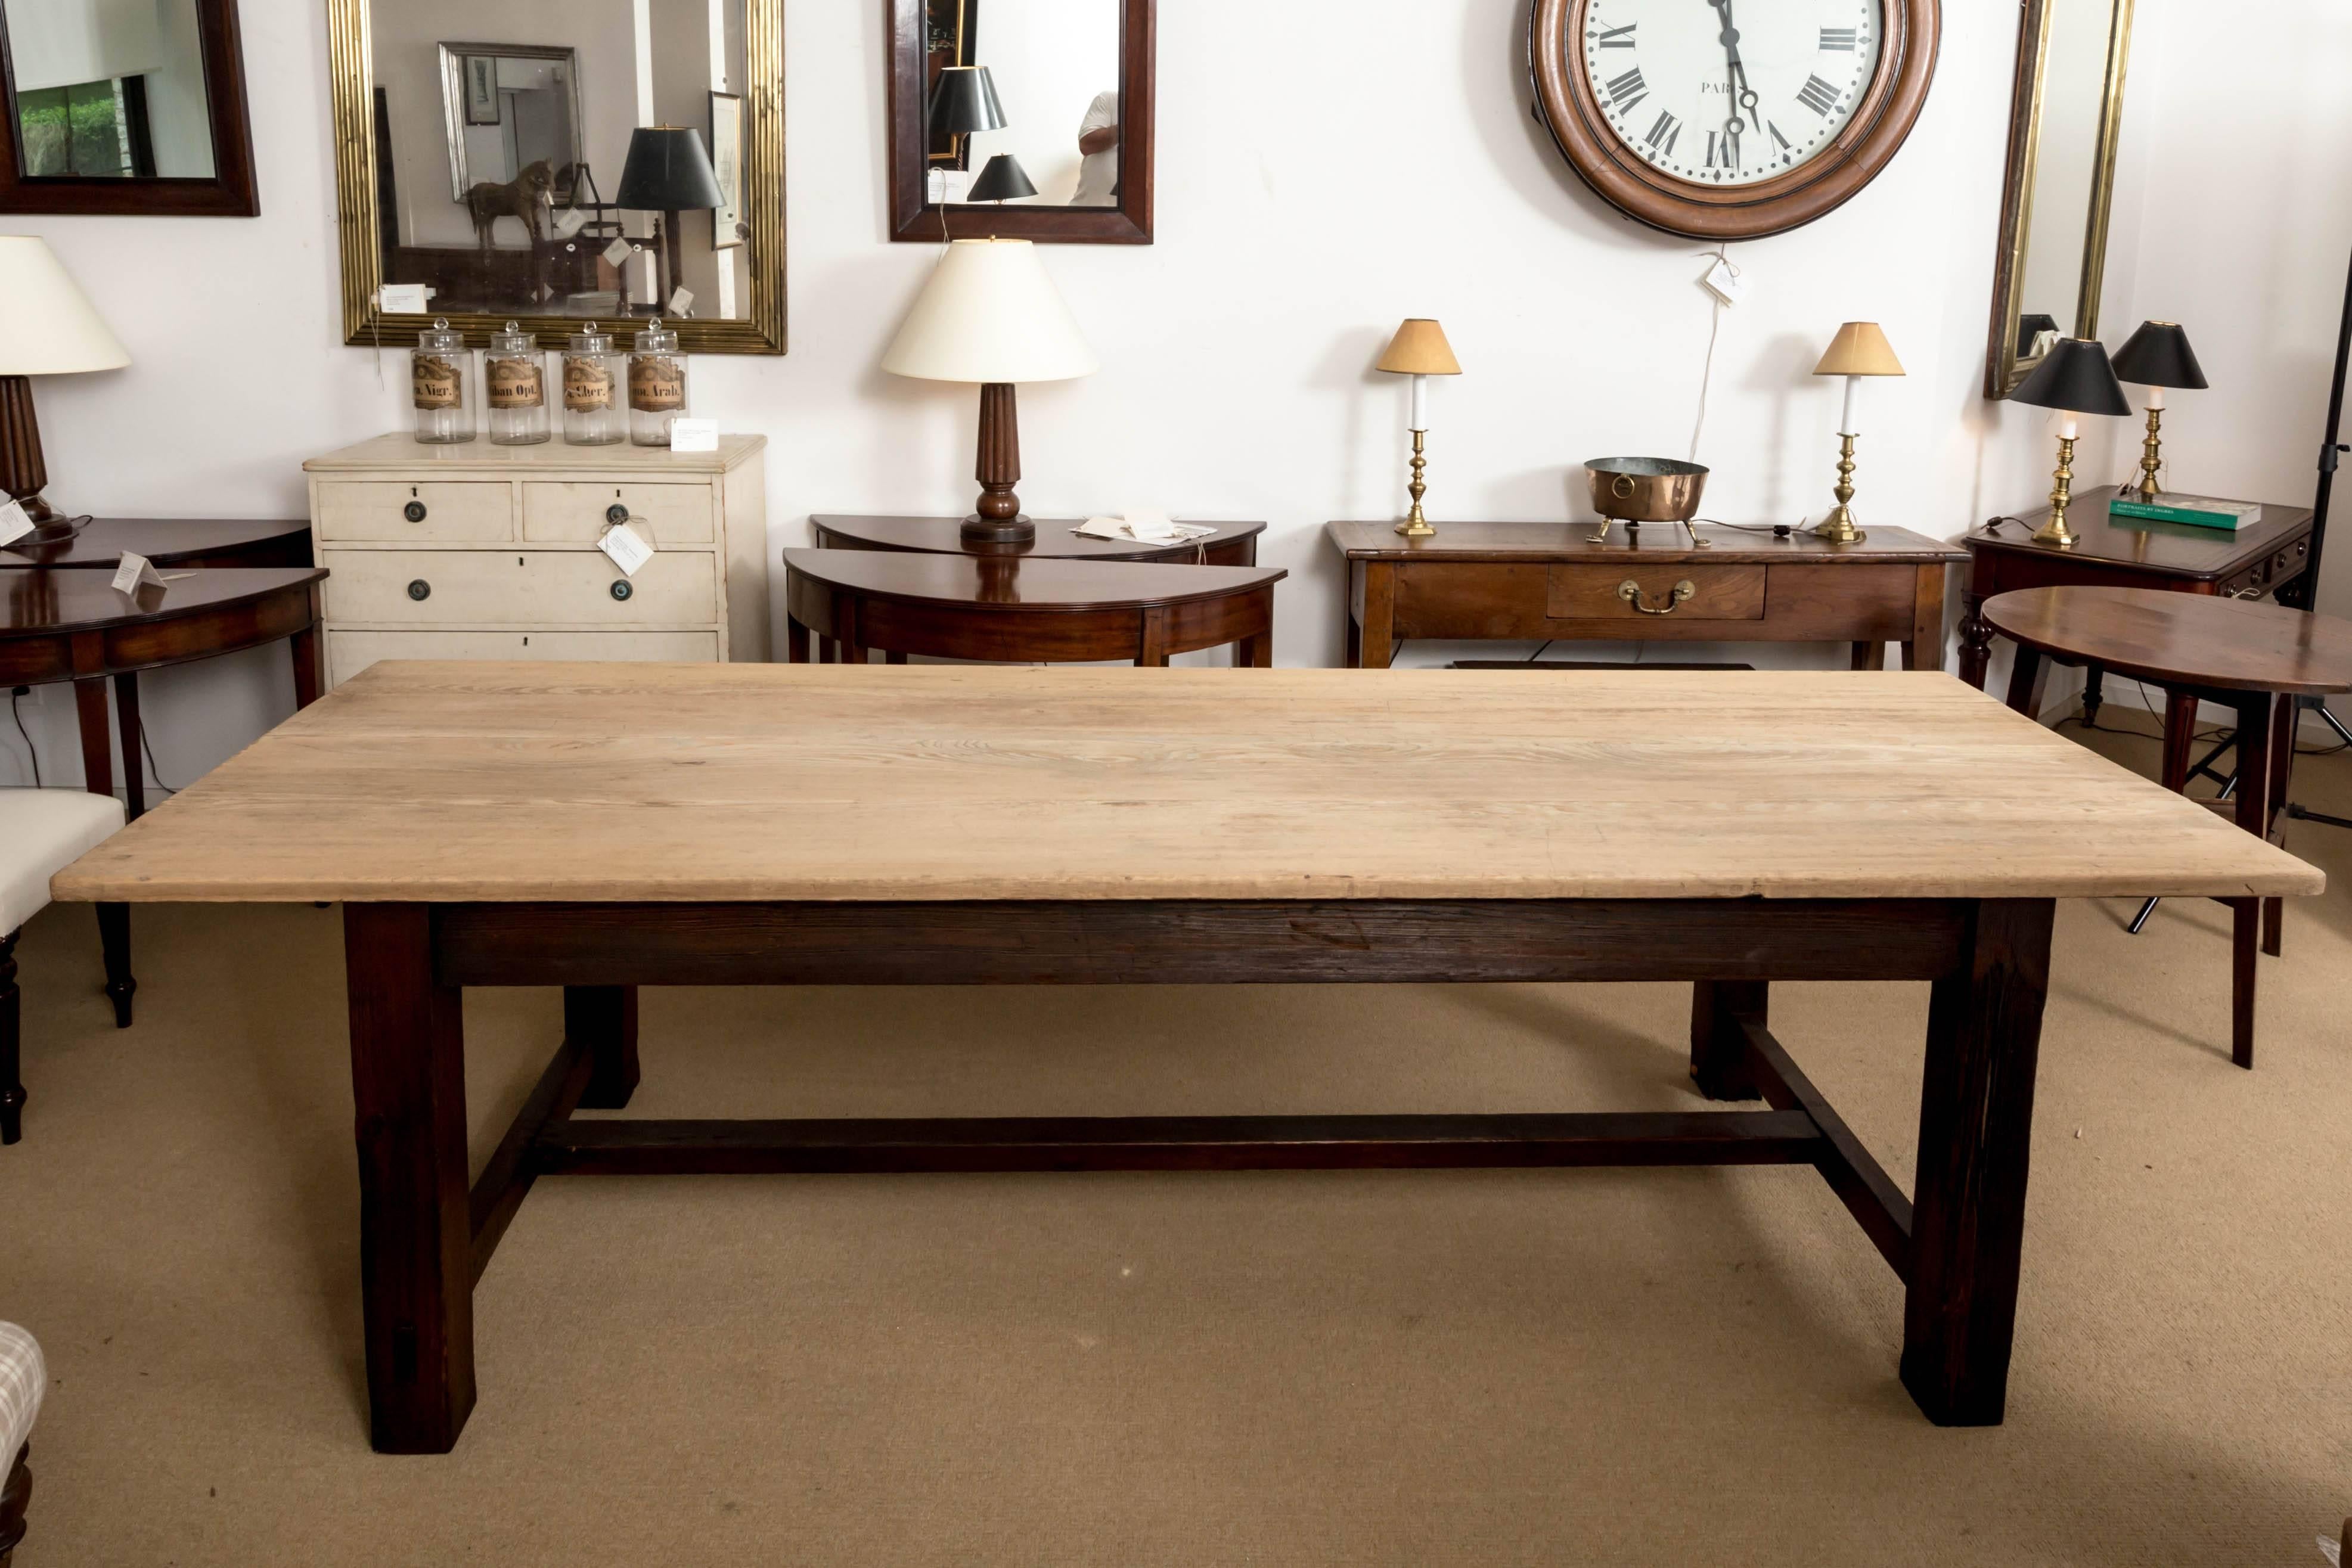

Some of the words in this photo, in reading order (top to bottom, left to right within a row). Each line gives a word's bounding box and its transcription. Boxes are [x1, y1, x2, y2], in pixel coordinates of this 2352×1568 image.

[1599, 19, 1637, 51] IX
[1818, 24, 1857, 55] III
[1605, 63, 1649, 119] VIII
[1701, 82, 1740, 94] PAR
[1793, 71, 1843, 119] IIII
[1642, 108, 1683, 158] VII
[1768, 119, 1793, 157] V
[516, 384, 537, 398] Opt.
